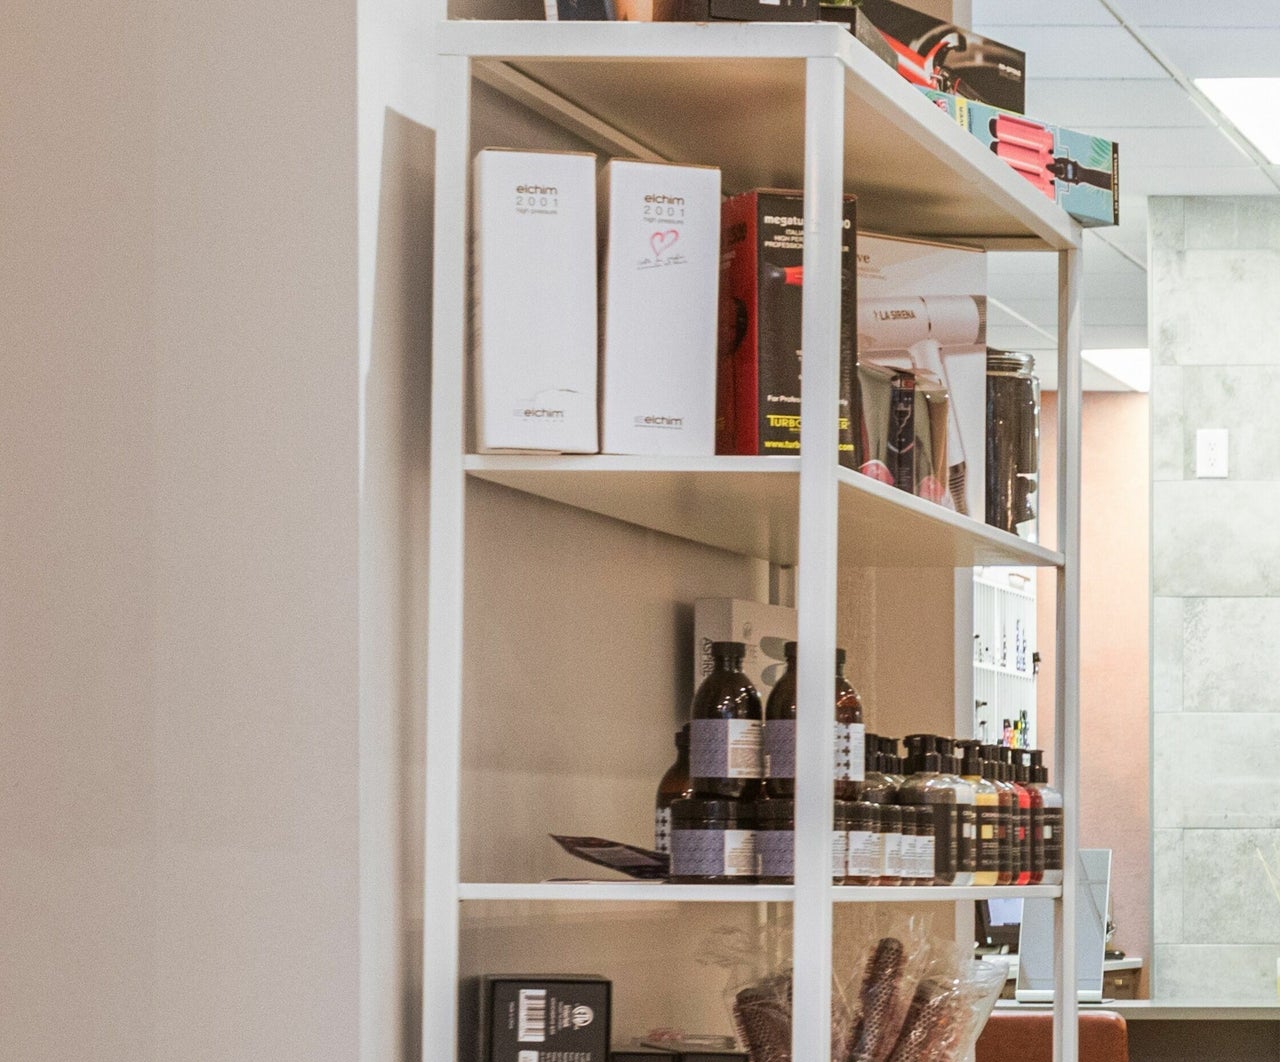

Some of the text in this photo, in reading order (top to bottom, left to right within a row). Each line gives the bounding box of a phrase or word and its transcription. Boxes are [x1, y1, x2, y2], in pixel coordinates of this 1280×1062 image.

[516, 184, 558, 195] elchim
[516, 196, 558, 207] 2001
[644, 194, 685, 205] elchim
[643, 205, 685, 217] 2001
[764, 215, 804, 227] megatu
[524, 408, 564, 418] elchim
[644, 414, 682, 426] elchim
